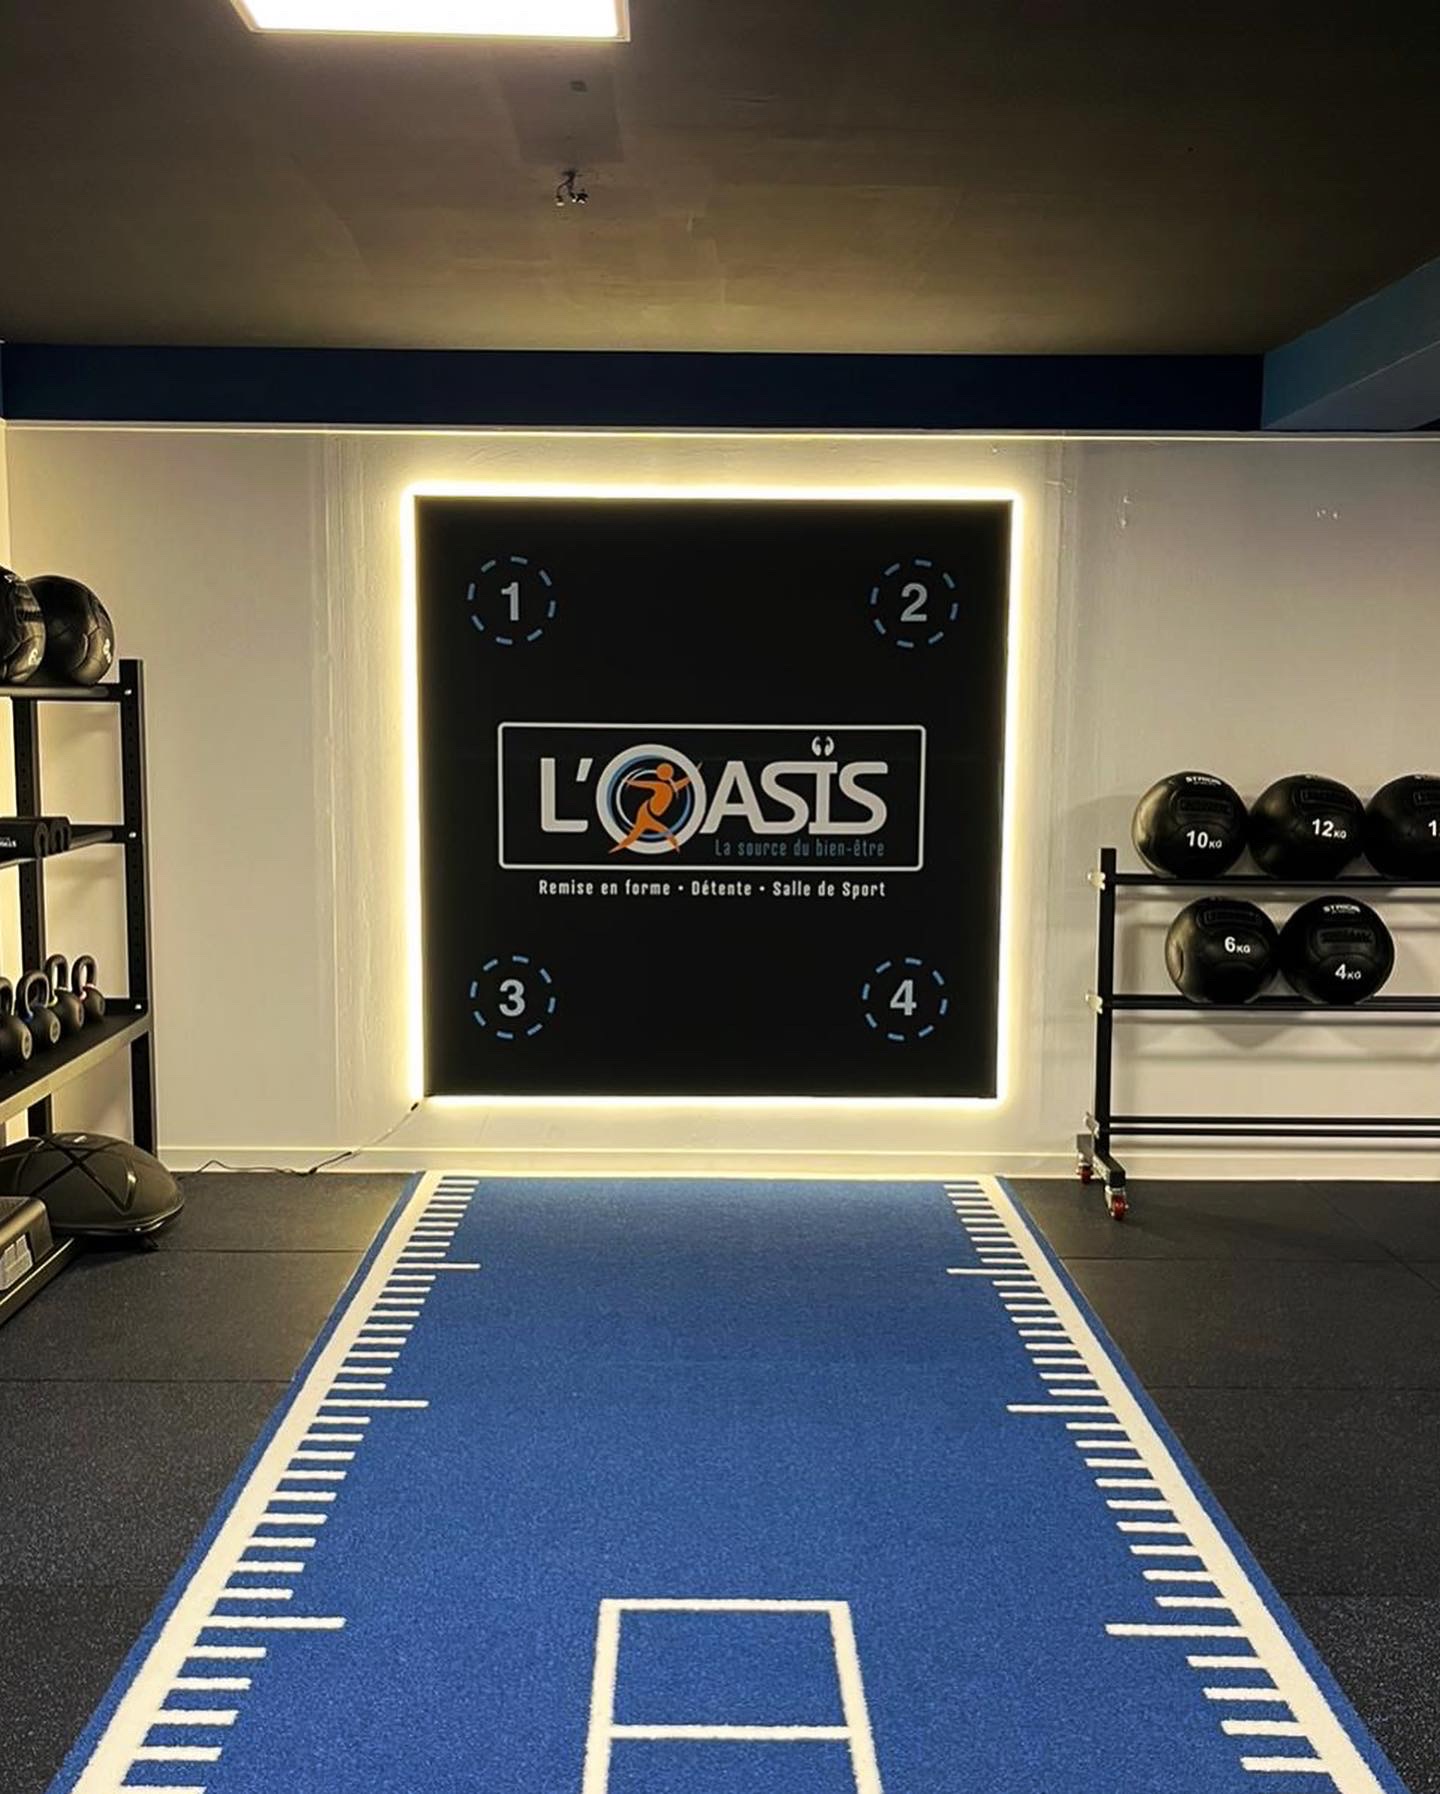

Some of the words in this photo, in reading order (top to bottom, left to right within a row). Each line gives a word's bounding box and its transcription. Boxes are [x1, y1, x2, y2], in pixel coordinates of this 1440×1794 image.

[501, 582, 520, 621] 1
[900, 583, 927, 622] 2
[1428, 819, 1440, 837] 1
[715, 839, 731, 856] La
[737, 842, 787, 856] source
[793, 839, 809, 856] du
[816, 839, 884, 857] bien-être
[538, 879, 594, 896] Remise
[600, 882, 618, 896] en
[625, 879, 671, 896] forme
[691, 879, 752, 896] Détente
[772, 880, 811, 897] Salle
[818, 880, 835, 897] de
[842, 881, 886, 900] Sport
[499, 979, 526, 1017] 3
[890, 979, 917, 1016] 4
